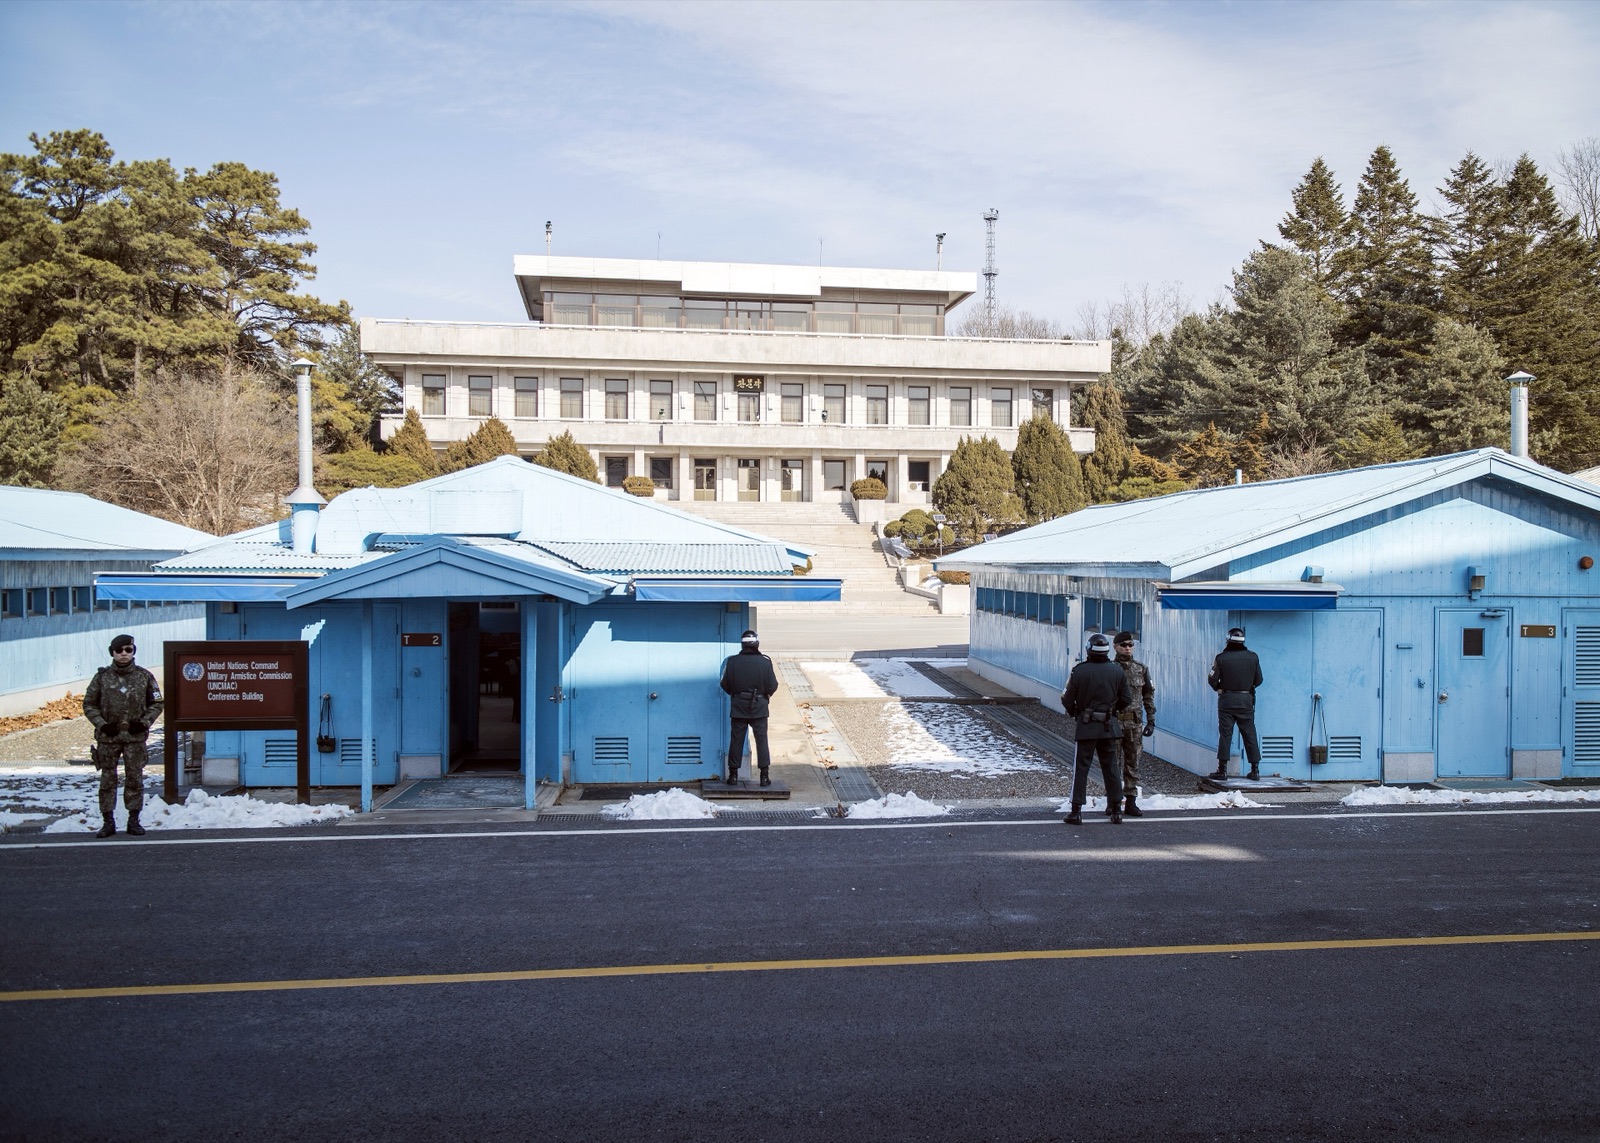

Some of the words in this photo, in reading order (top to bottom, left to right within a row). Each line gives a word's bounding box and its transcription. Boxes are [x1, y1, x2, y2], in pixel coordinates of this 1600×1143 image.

[1522, 626, 1528, 636] T
[1548, 627, 1554, 636] 3
[403, 635, 410, 645] T
[432, 635, 439, 645] 2
[207, 661, 225, 670] United
[227, 661, 249, 670] Nations
[250, 661, 279, 670] Command
[207, 671, 228, 681] Military
[230, 671, 257, 680] Armistice
[258, 671, 293, 680] Commission
[207, 681, 238, 691] (UNCMAC)
[207, 692, 240, 701] Conference
[241, 692, 264, 702] Building
